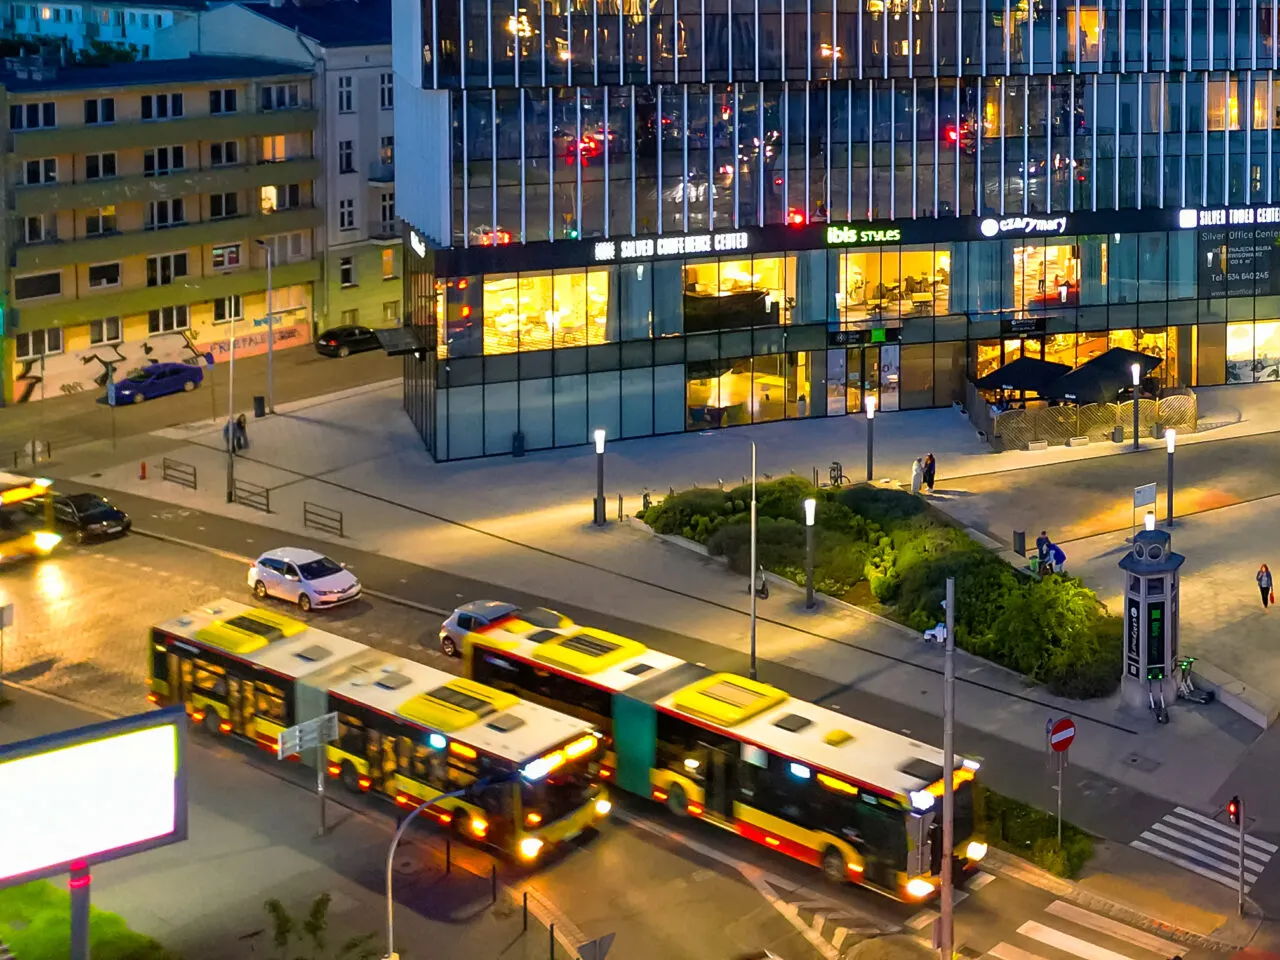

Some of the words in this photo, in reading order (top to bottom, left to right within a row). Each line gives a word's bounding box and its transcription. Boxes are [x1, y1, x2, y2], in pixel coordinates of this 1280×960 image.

[1200, 209, 1226, 226] SILVER
[1229, 208, 1254, 224] TOWER
[827, 226, 857, 243] ibis
[1202, 231, 1225, 241] Silver
[1229, 230, 1253, 240] Office
[1255, 229, 1280, 239] Center
